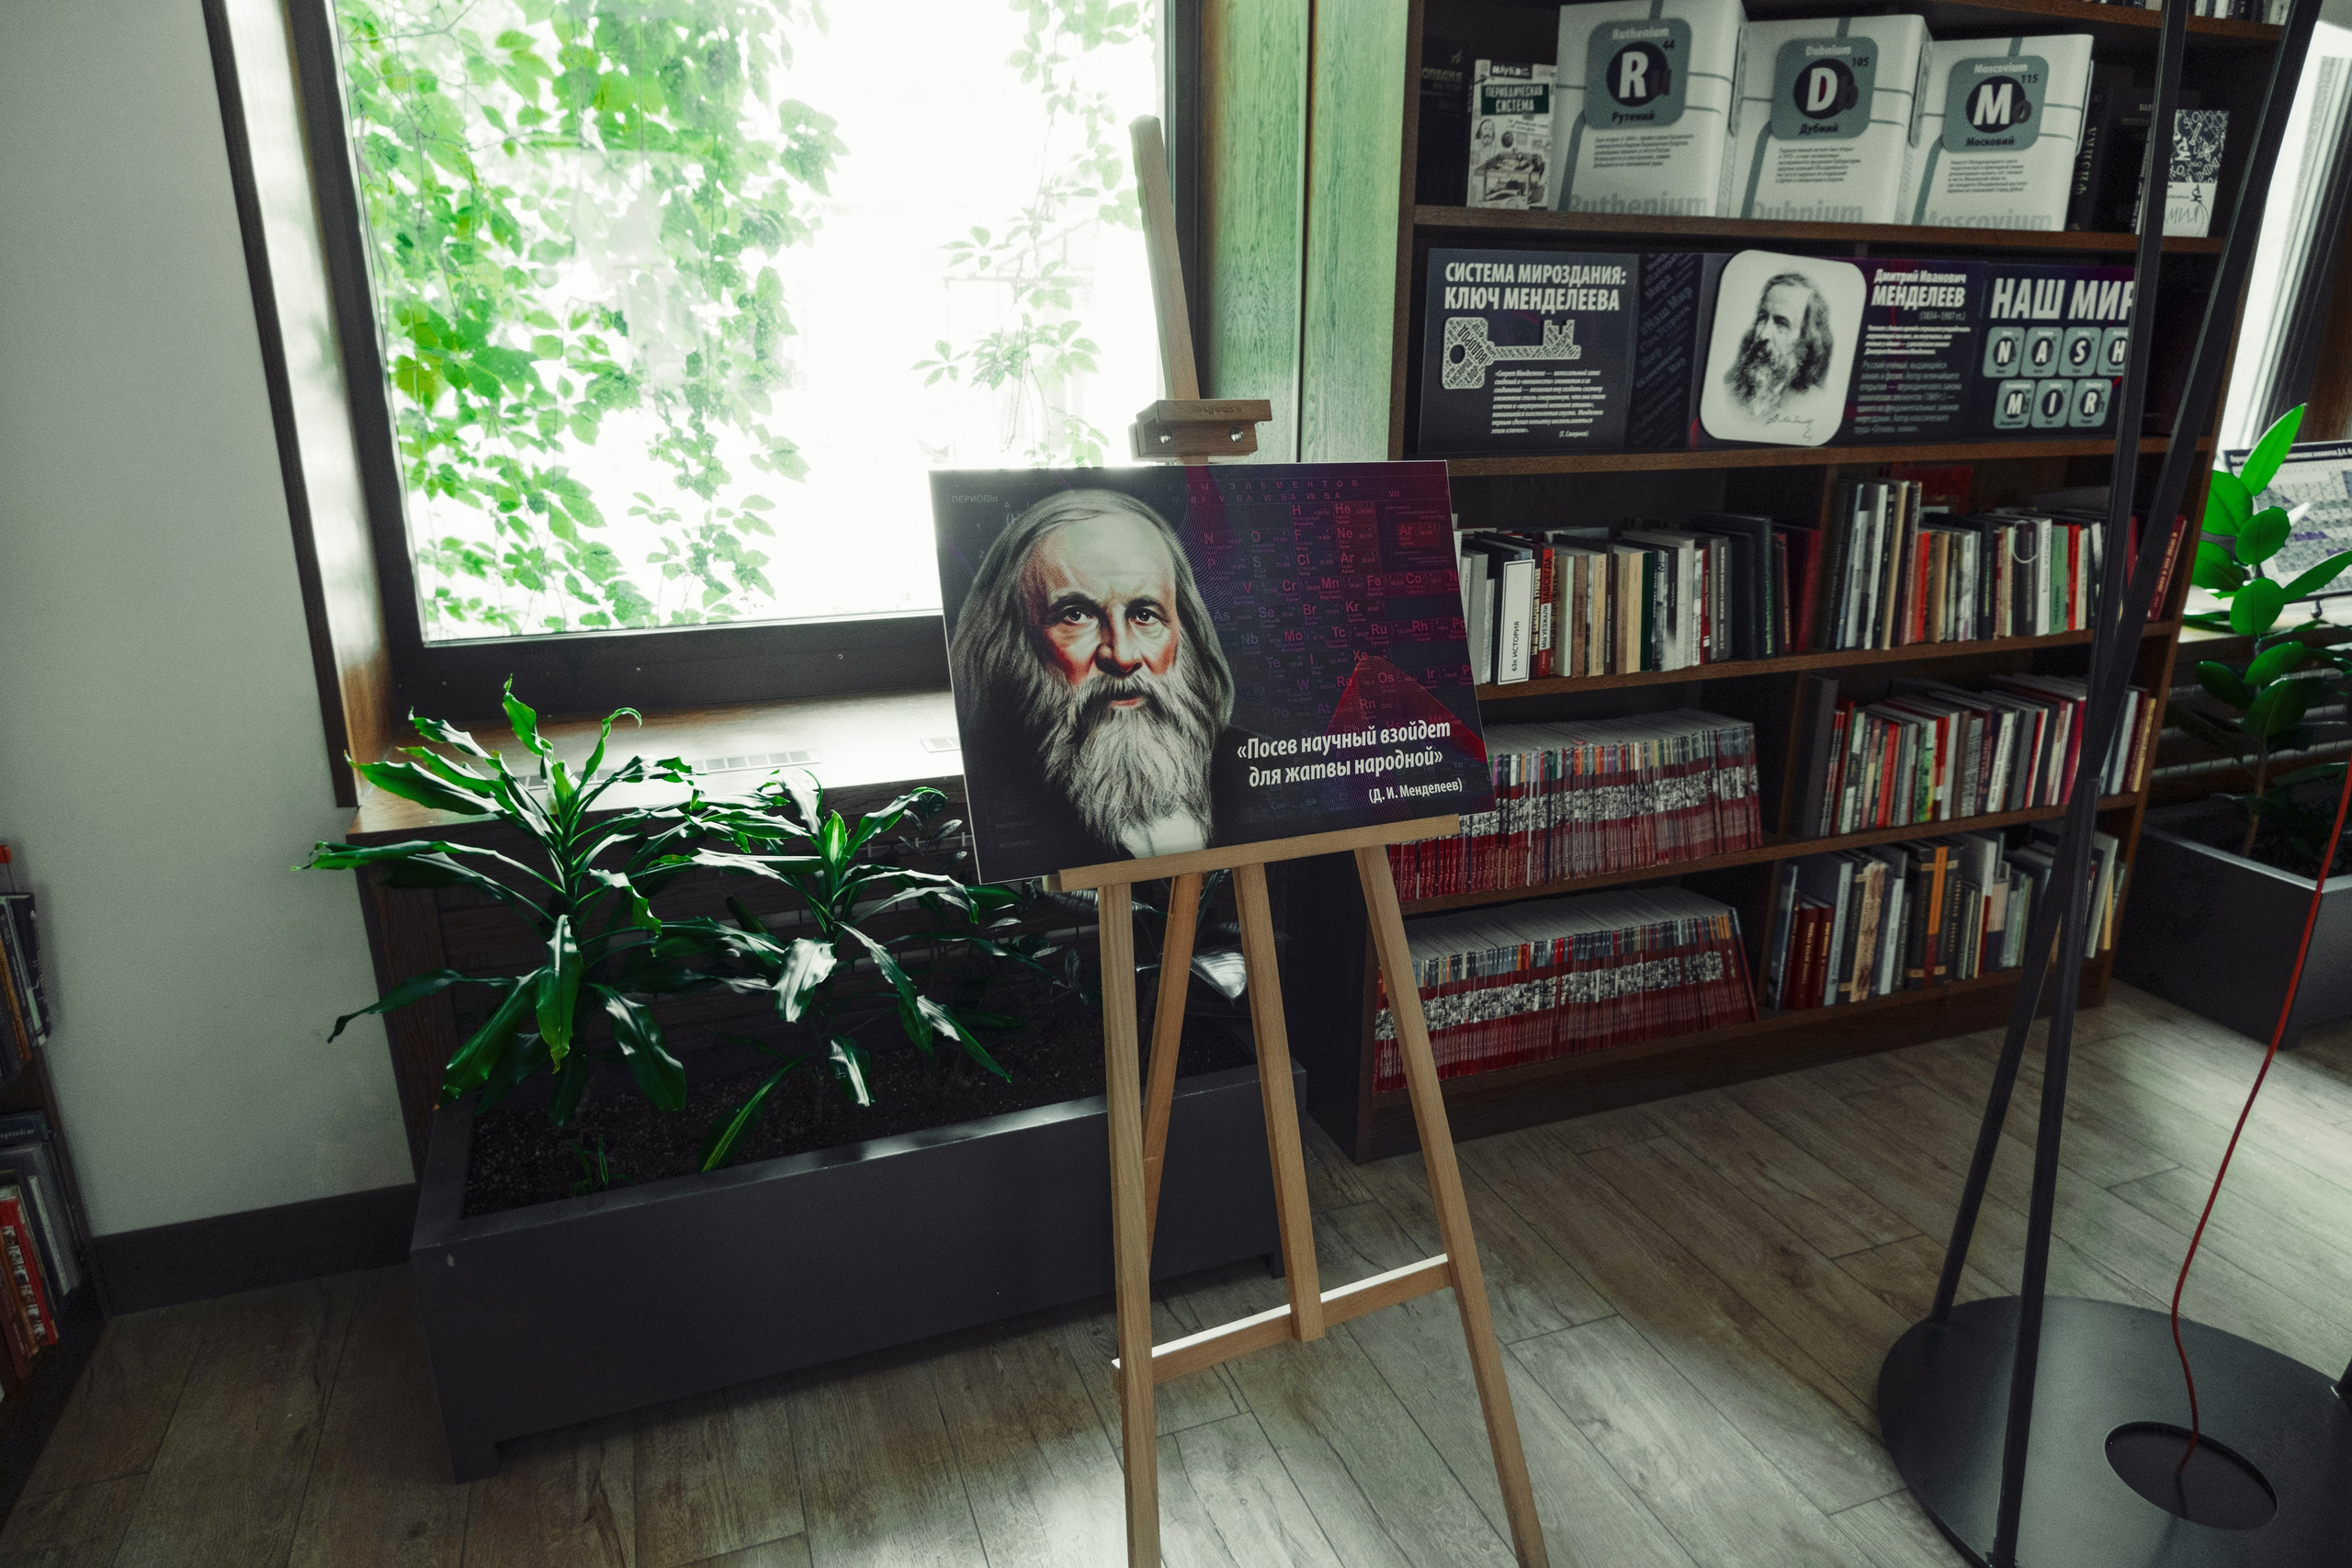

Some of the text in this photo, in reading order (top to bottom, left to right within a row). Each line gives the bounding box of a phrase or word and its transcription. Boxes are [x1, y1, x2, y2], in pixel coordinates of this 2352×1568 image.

[1973, 62, 2028, 73] Moscovium
[1495, 98, 1535, 113] СИСТЕМА
[1611, 111, 1655, 124] Рутений
[1964, 136, 2015, 147] Московий
[1445, 262, 1515, 283] СИСТЕМА
[1518, 264, 1627, 288] МИРОЗДАНИЯ:
[1873, 268, 1967, 285] Дмитрий Иванович
[1444, 287, 1621, 314] КЛЮЧ МЕНДЕЛЕЕВА
[1871, 285, 1966, 310] МЕНДЕЛЕЕВ
[1989, 277, 2066, 320] НАШ
[1457, 323, 1488, 365] ВОДОРОД
[951, 494, 999, 503] ПЕРИОДЫ
[1334, 502, 1351, 514] He
[1336, 528, 1353, 539] Ne
[1340, 552, 1354, 564] Ar
[1321, 577, 1340, 589] Mn
[1366, 575, 1382, 587] Fe
[1405, 572, 1422, 584] Co
[1543, 556, 1552, 604] НАВСЕГДА
[1302, 604, 1317, 615] Br
[1345, 601, 1360, 613] Kr
[1331, 626, 1347, 638] Tc
[1371, 623, 1387, 635] Ru
[1411, 620, 1428, 632] Rh
[1283, 630, 1303, 642] Mo
[1541, 636, 1548, 649] МЫ
[1237, 719, 1451, 760] «Посев научный взойдет
[1249, 746, 1443, 788] для жатвы народной»
[1368, 777, 1463, 805] (Д. И. Менделеев)
